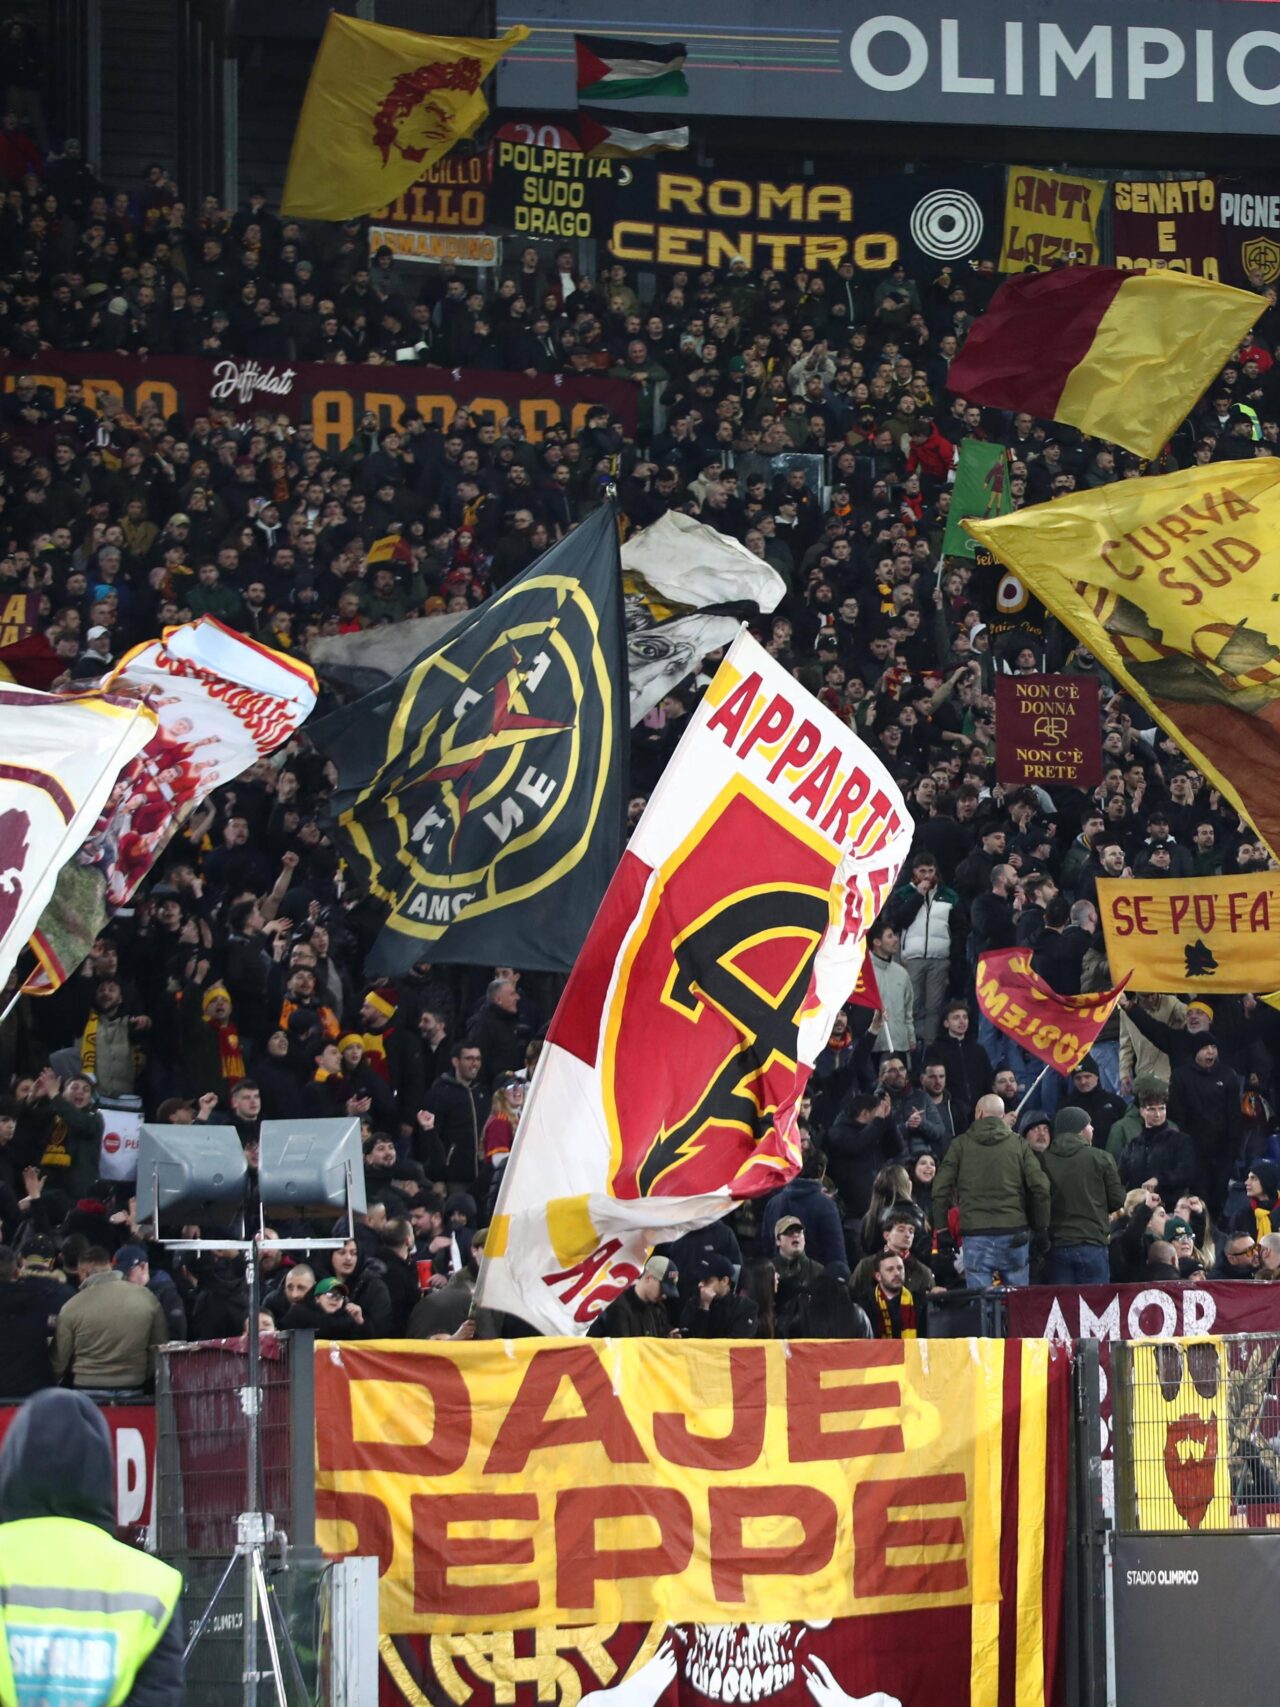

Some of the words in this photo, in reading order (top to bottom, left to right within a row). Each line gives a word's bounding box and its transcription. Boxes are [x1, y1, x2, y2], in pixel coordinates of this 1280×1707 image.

[499, 142, 613, 179] POLPETTA
[522, 176, 585, 209] SUDO
[656, 172, 854, 222] ROMA
[1014, 175, 1091, 223] ANTI
[1114, 179, 1215, 215] SENATO
[514, 205, 592, 238] DRAGO
[1157, 220, 1177, 253] E
[607, 219, 899, 272] CENTRO
[210, 359, 298, 404] Diffidati
[1100, 486, 1261, 581] CURVA
[1157, 535, 1262, 607] SUD
[1016, 684, 1049, 698] NON
[1053, 681, 1080, 699] C'È
[1020, 701, 1076, 717] DONNA
[1016, 748, 1051, 763] NON
[1055, 746, 1084, 764] C'È
[1023, 764, 1078, 780] PRETE
[1112, 895, 1159, 936] SE
[1043, 1288, 1218, 1340] AMOR
[315, 1337, 906, 1478] DAJE
[1126, 1570, 1157, 1585] STADIO
[1157, 1569, 1200, 1586] OLIMPICO
